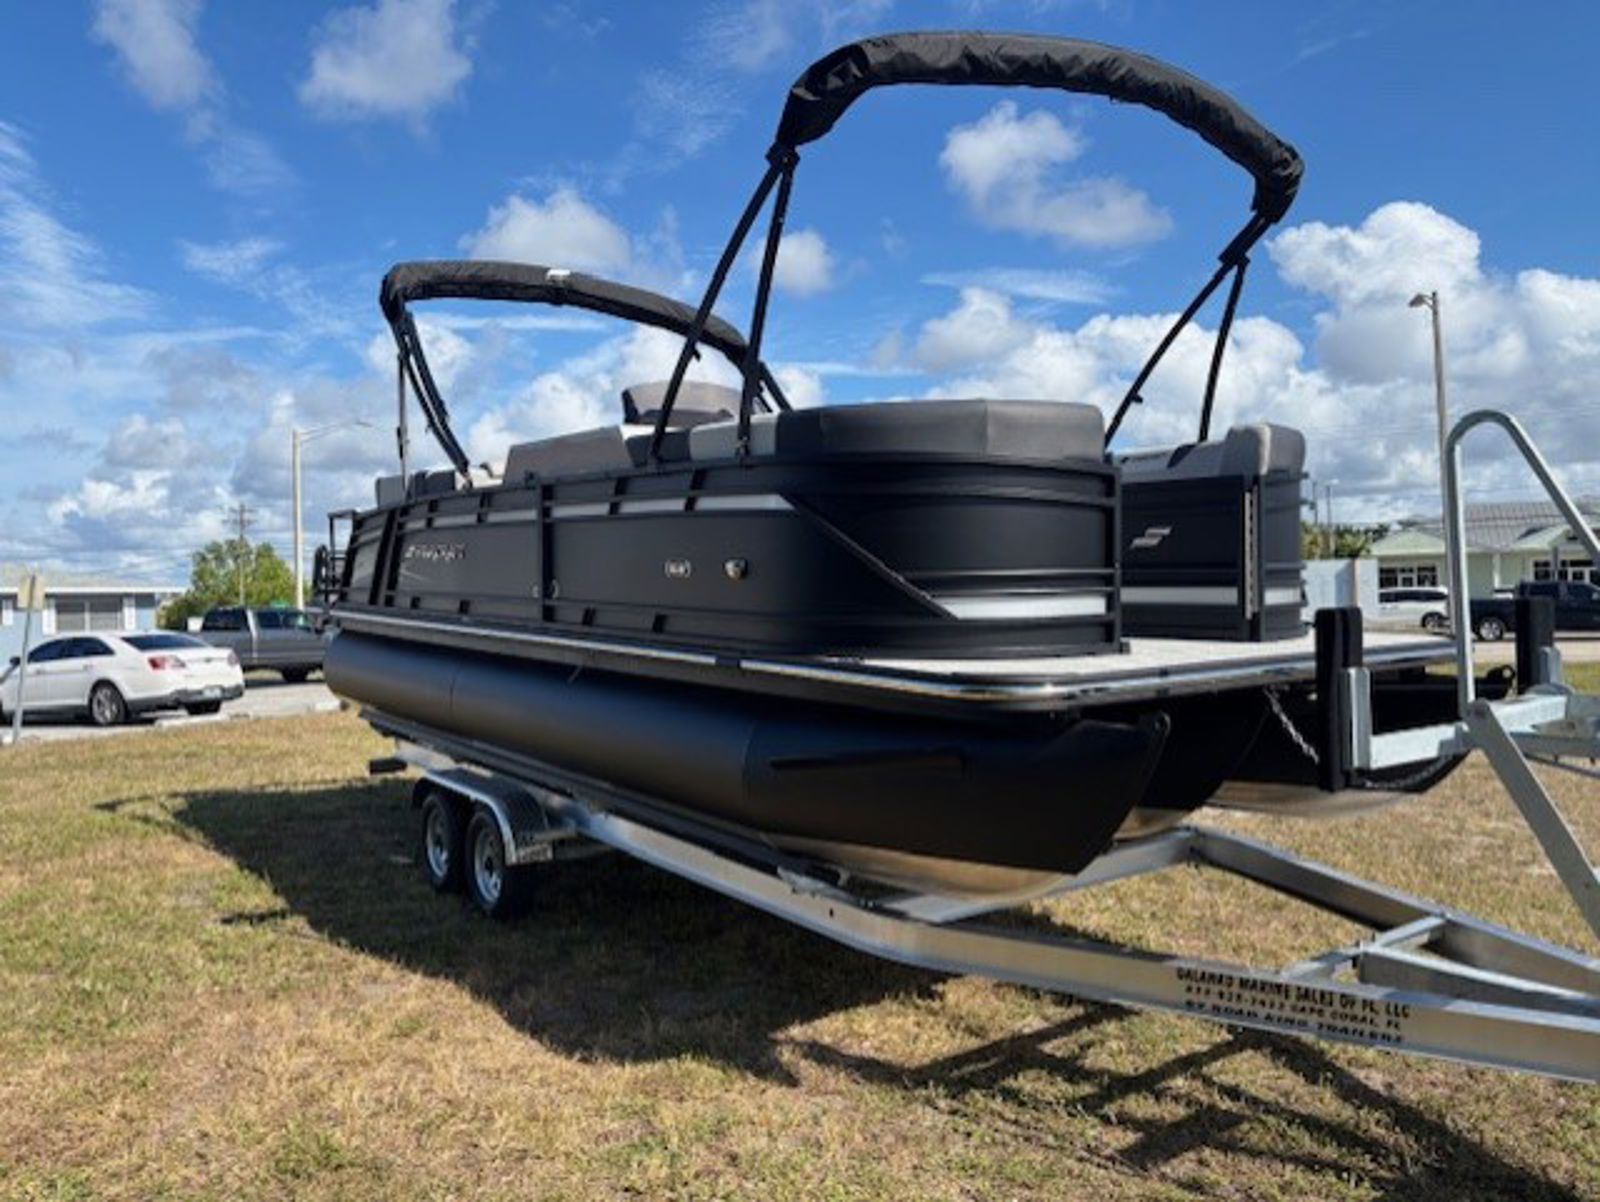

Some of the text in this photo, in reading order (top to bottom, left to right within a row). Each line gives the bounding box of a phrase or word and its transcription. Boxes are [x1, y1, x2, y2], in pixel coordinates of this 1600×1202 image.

[1239, 975, 1290, 999] MARINE
[1294, 985, 1333, 1007] SALES
[1340, 994, 1356, 1010] OF
[1384, 1003, 1411, 1019] LLC
